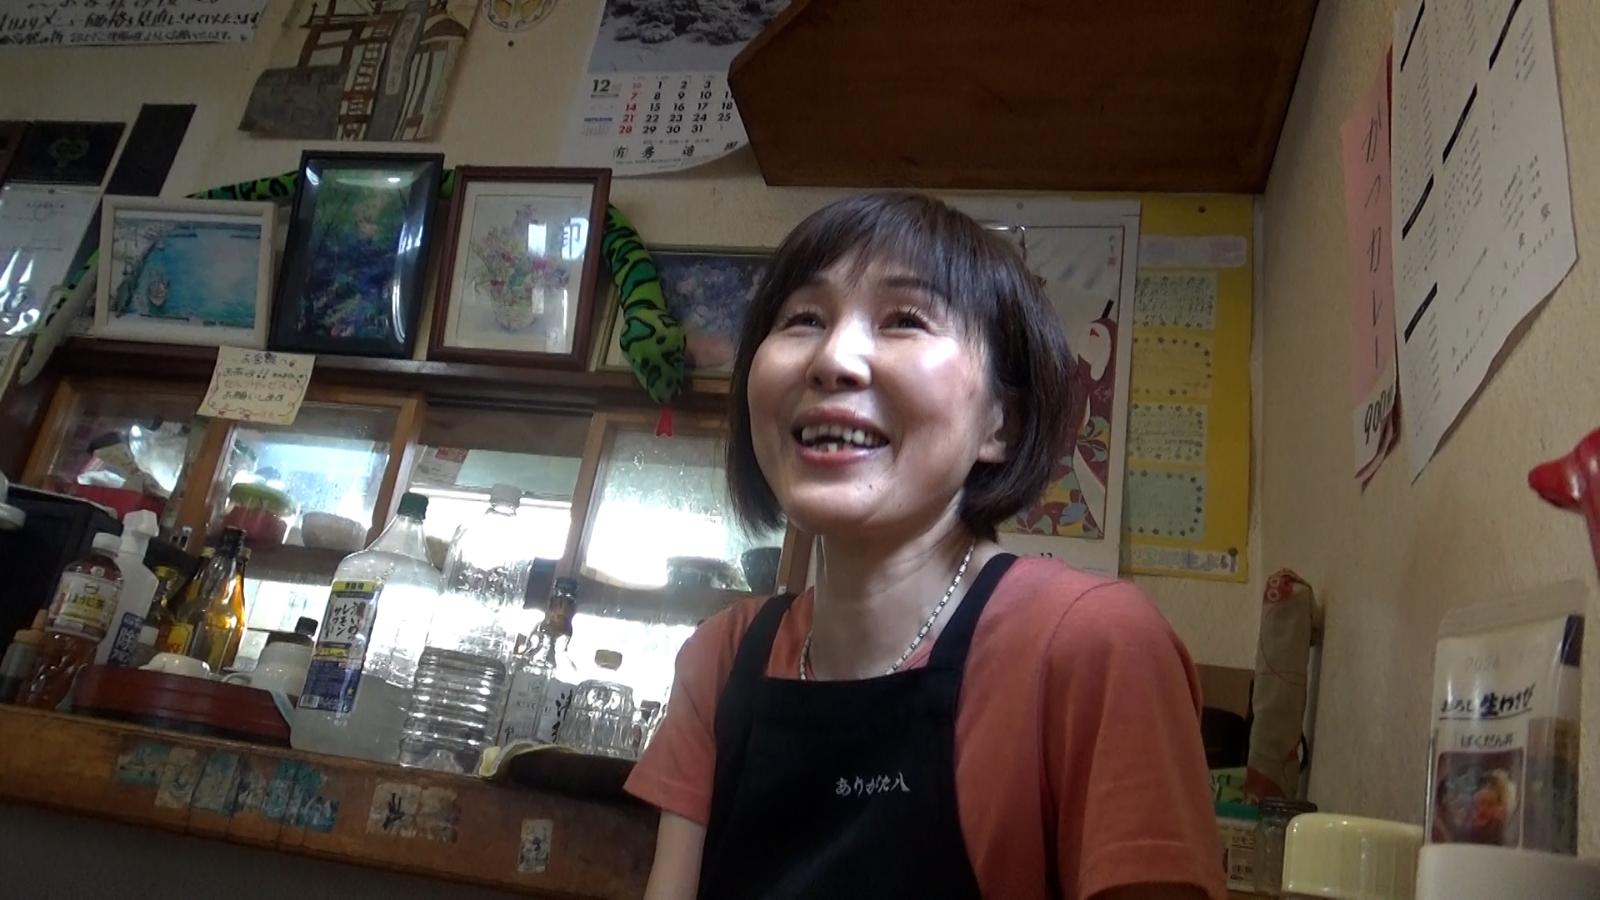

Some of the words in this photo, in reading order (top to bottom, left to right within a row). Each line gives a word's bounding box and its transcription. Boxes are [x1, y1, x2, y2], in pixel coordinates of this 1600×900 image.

[593, 79, 611, 92] 12
[658, 81, 662, 89] 1
[680, 81, 687, 89] 2
[703, 81, 711, 89] 3
[630, 92, 638, 100] 7
[654, 91, 661, 99] 8
[678, 91, 685, 99] 9
[700, 91, 712, 99] 10
[625, 103, 637, 111] 14
[650, 103, 661, 112] 15
[673, 102, 685, 111] 16
[697, 102, 709, 110] 17
[722, 102, 733, 110] 18
[623, 114, 634, 122] 21
[646, 114, 660, 122] 22
[669, 114, 683, 122] 23
[692, 113, 707, 122] 24
[717, 112, 731, 121] 25
[618, 126, 633, 134] 28
[642, 126, 657, 134] 29
[666, 125, 681, 134] 30
[691, 124, 703, 133] 31
